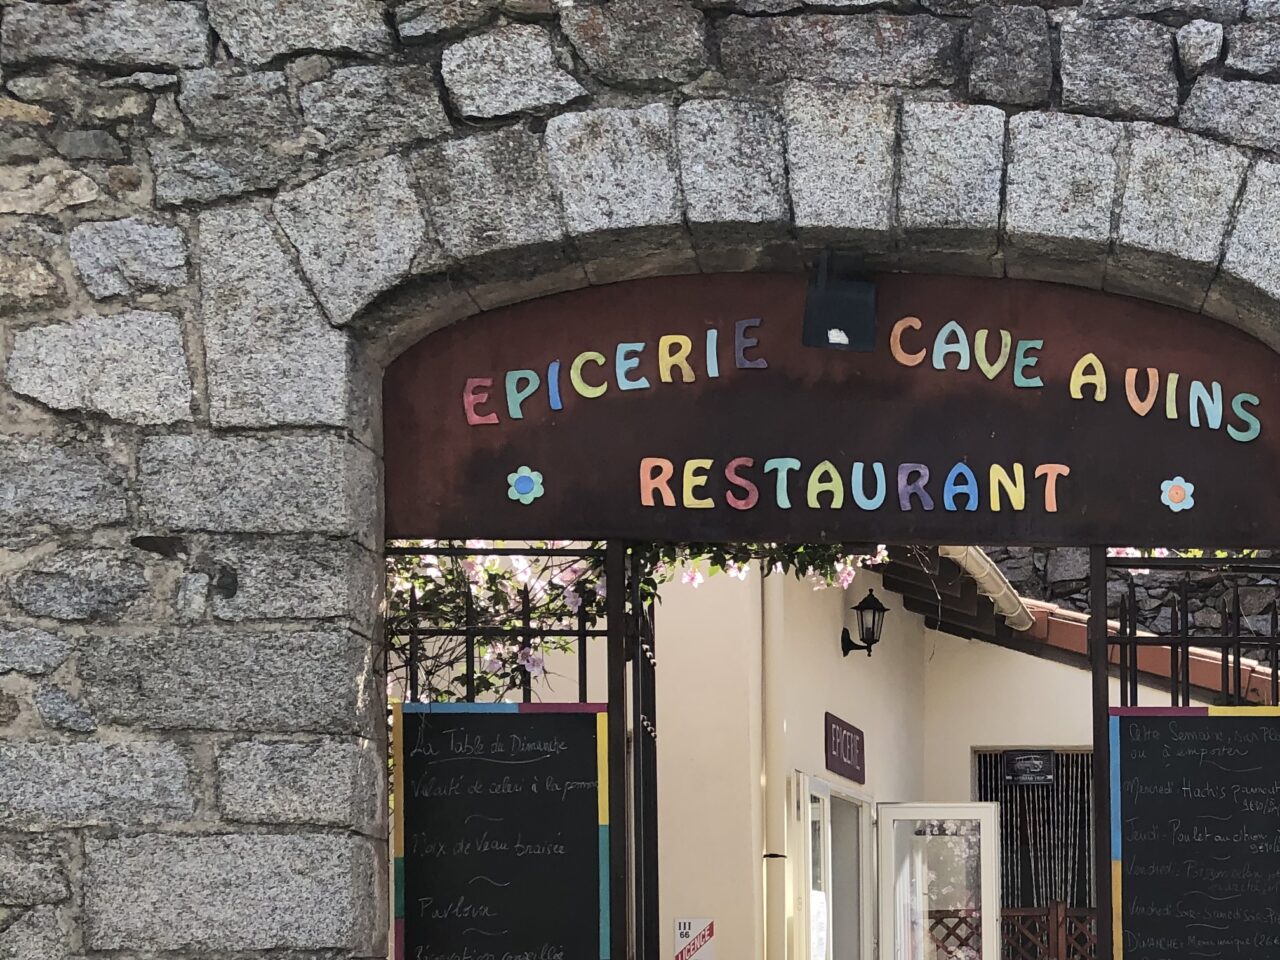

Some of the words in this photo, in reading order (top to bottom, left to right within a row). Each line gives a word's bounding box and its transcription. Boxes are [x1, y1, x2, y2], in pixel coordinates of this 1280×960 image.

[463, 318, 768, 425] EPICERIE
[890, 316, 1044, 388] CAVE
[1069, 353, 1107, 402] A
[1124, 367, 1261, 442] VINS
[640, 457, 1070, 512] RESTAURANT
[442, 727, 485, 755] Table
[1181, 776, 1226, 799] Hachis
[679, 931, 690, 939] 66
